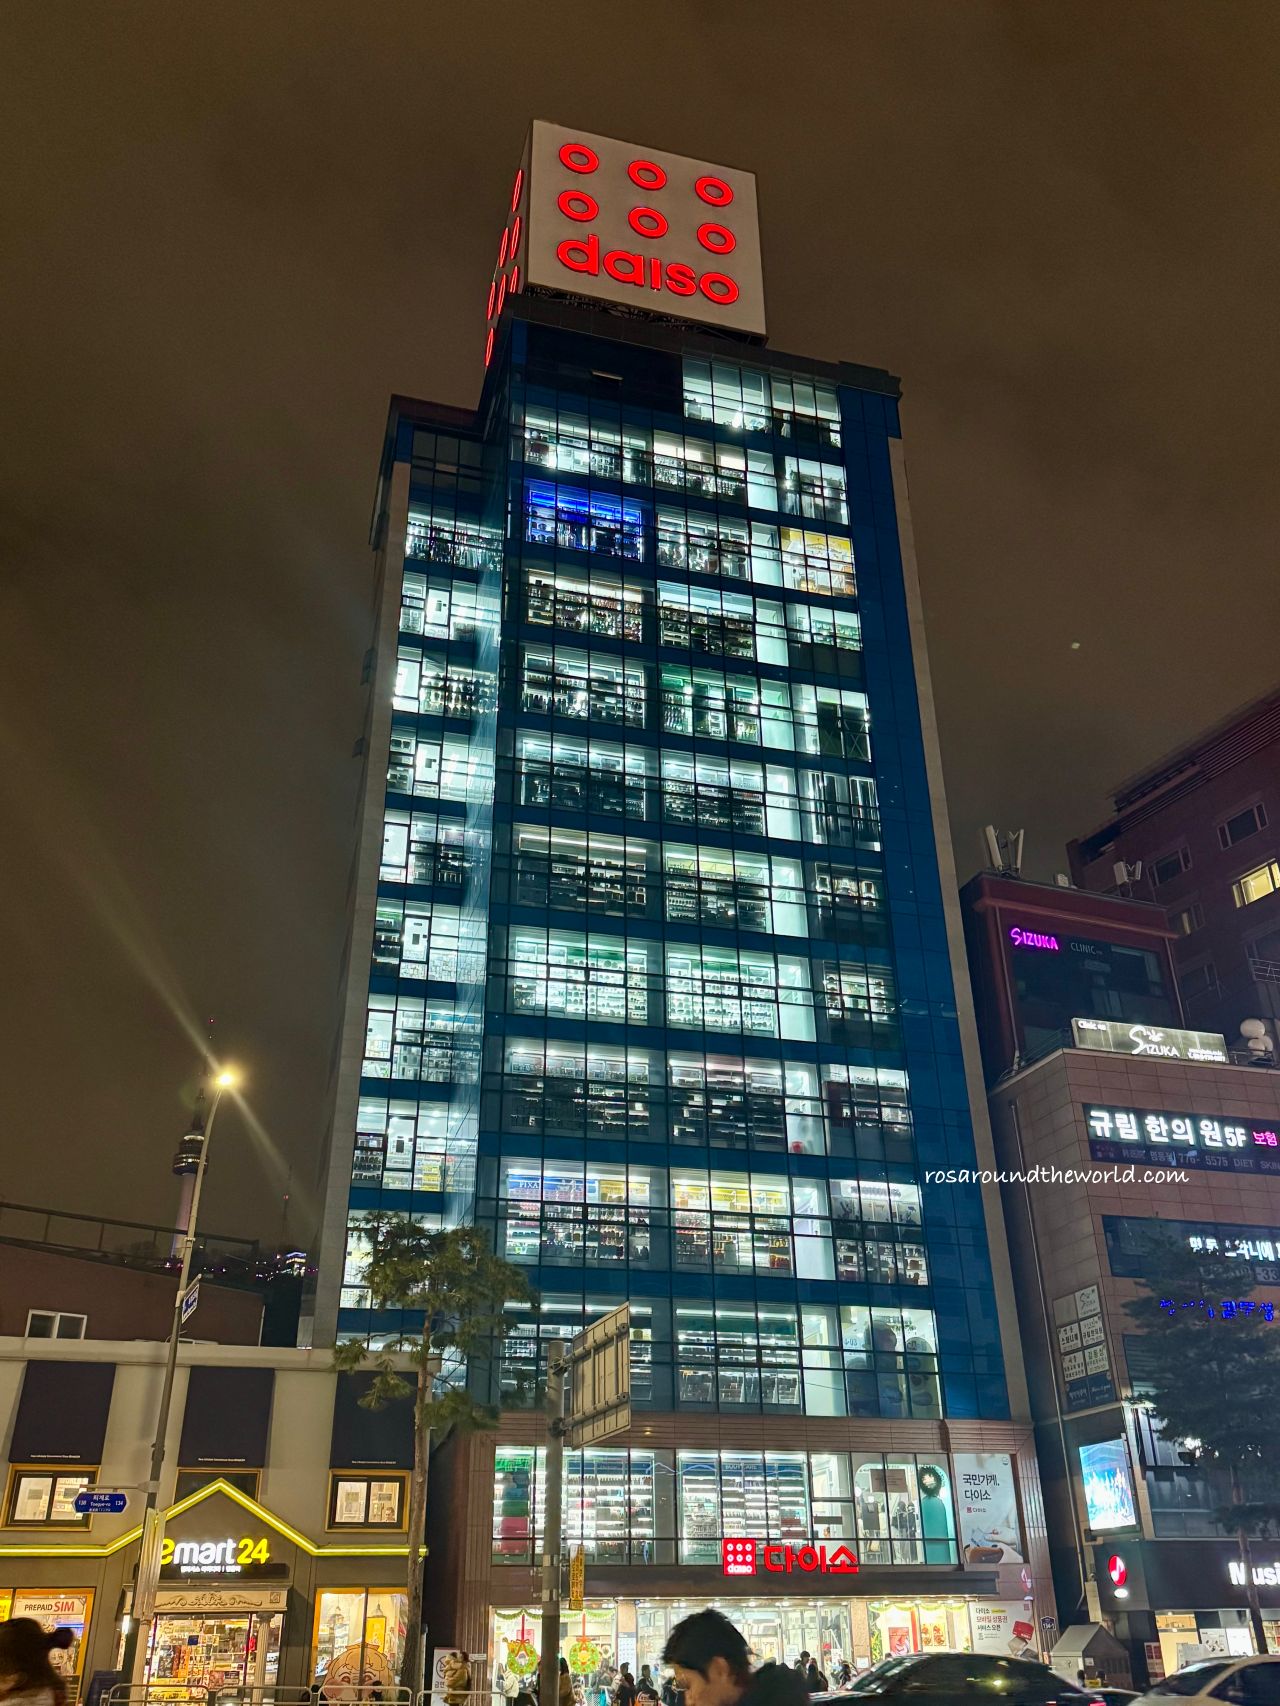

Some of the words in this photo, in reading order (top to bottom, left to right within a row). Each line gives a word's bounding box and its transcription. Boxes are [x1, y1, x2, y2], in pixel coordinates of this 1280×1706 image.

[556, 234, 740, 305] daiso
[1010, 927, 1059, 950] SIZUKA
[962, 1473, 1000, 1487] 국민가게,
[964, 1489, 992, 1501] 다이소
[763, 1545, 859, 1574] 다이소
[24, 1604, 53, 1612] PREPAID
[54, 1601, 75, 1613] SIM
